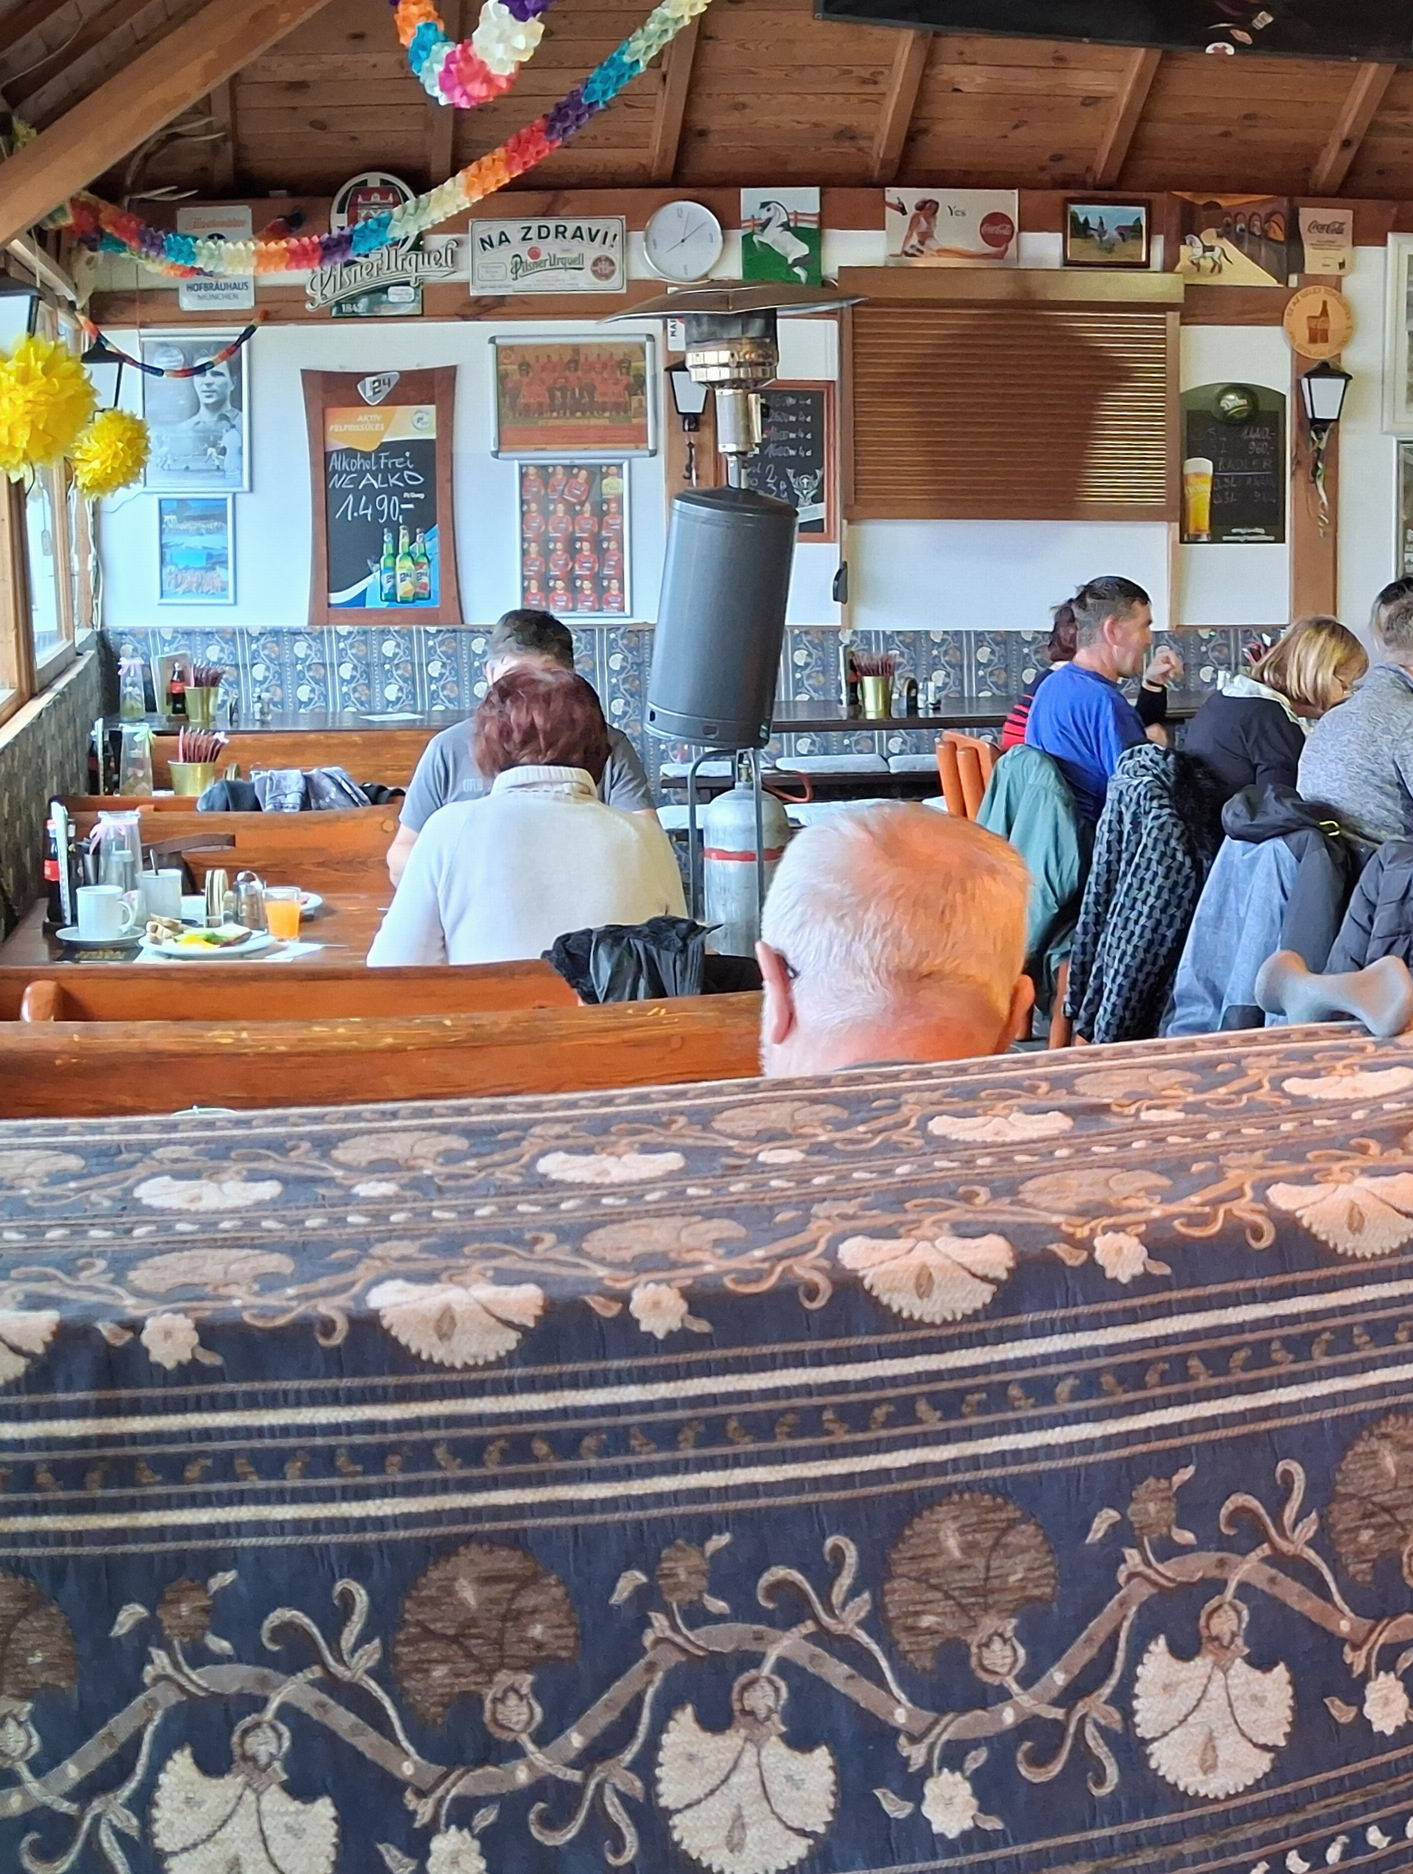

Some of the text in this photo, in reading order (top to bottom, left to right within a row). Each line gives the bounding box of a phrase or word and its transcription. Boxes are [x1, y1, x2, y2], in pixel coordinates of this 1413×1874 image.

[947, 205, 967, 216] Yes
[479, 230, 512, 252] NA
[304, 240, 460, 312] Pilsner Urquell
[510, 253, 549, 281] Pilsner
[547, 252, 585, 272] Urquell
[186, 280, 249, 293] HOFBRÄUHAUS
[328, 451, 414, 473] Alkohol Frei
